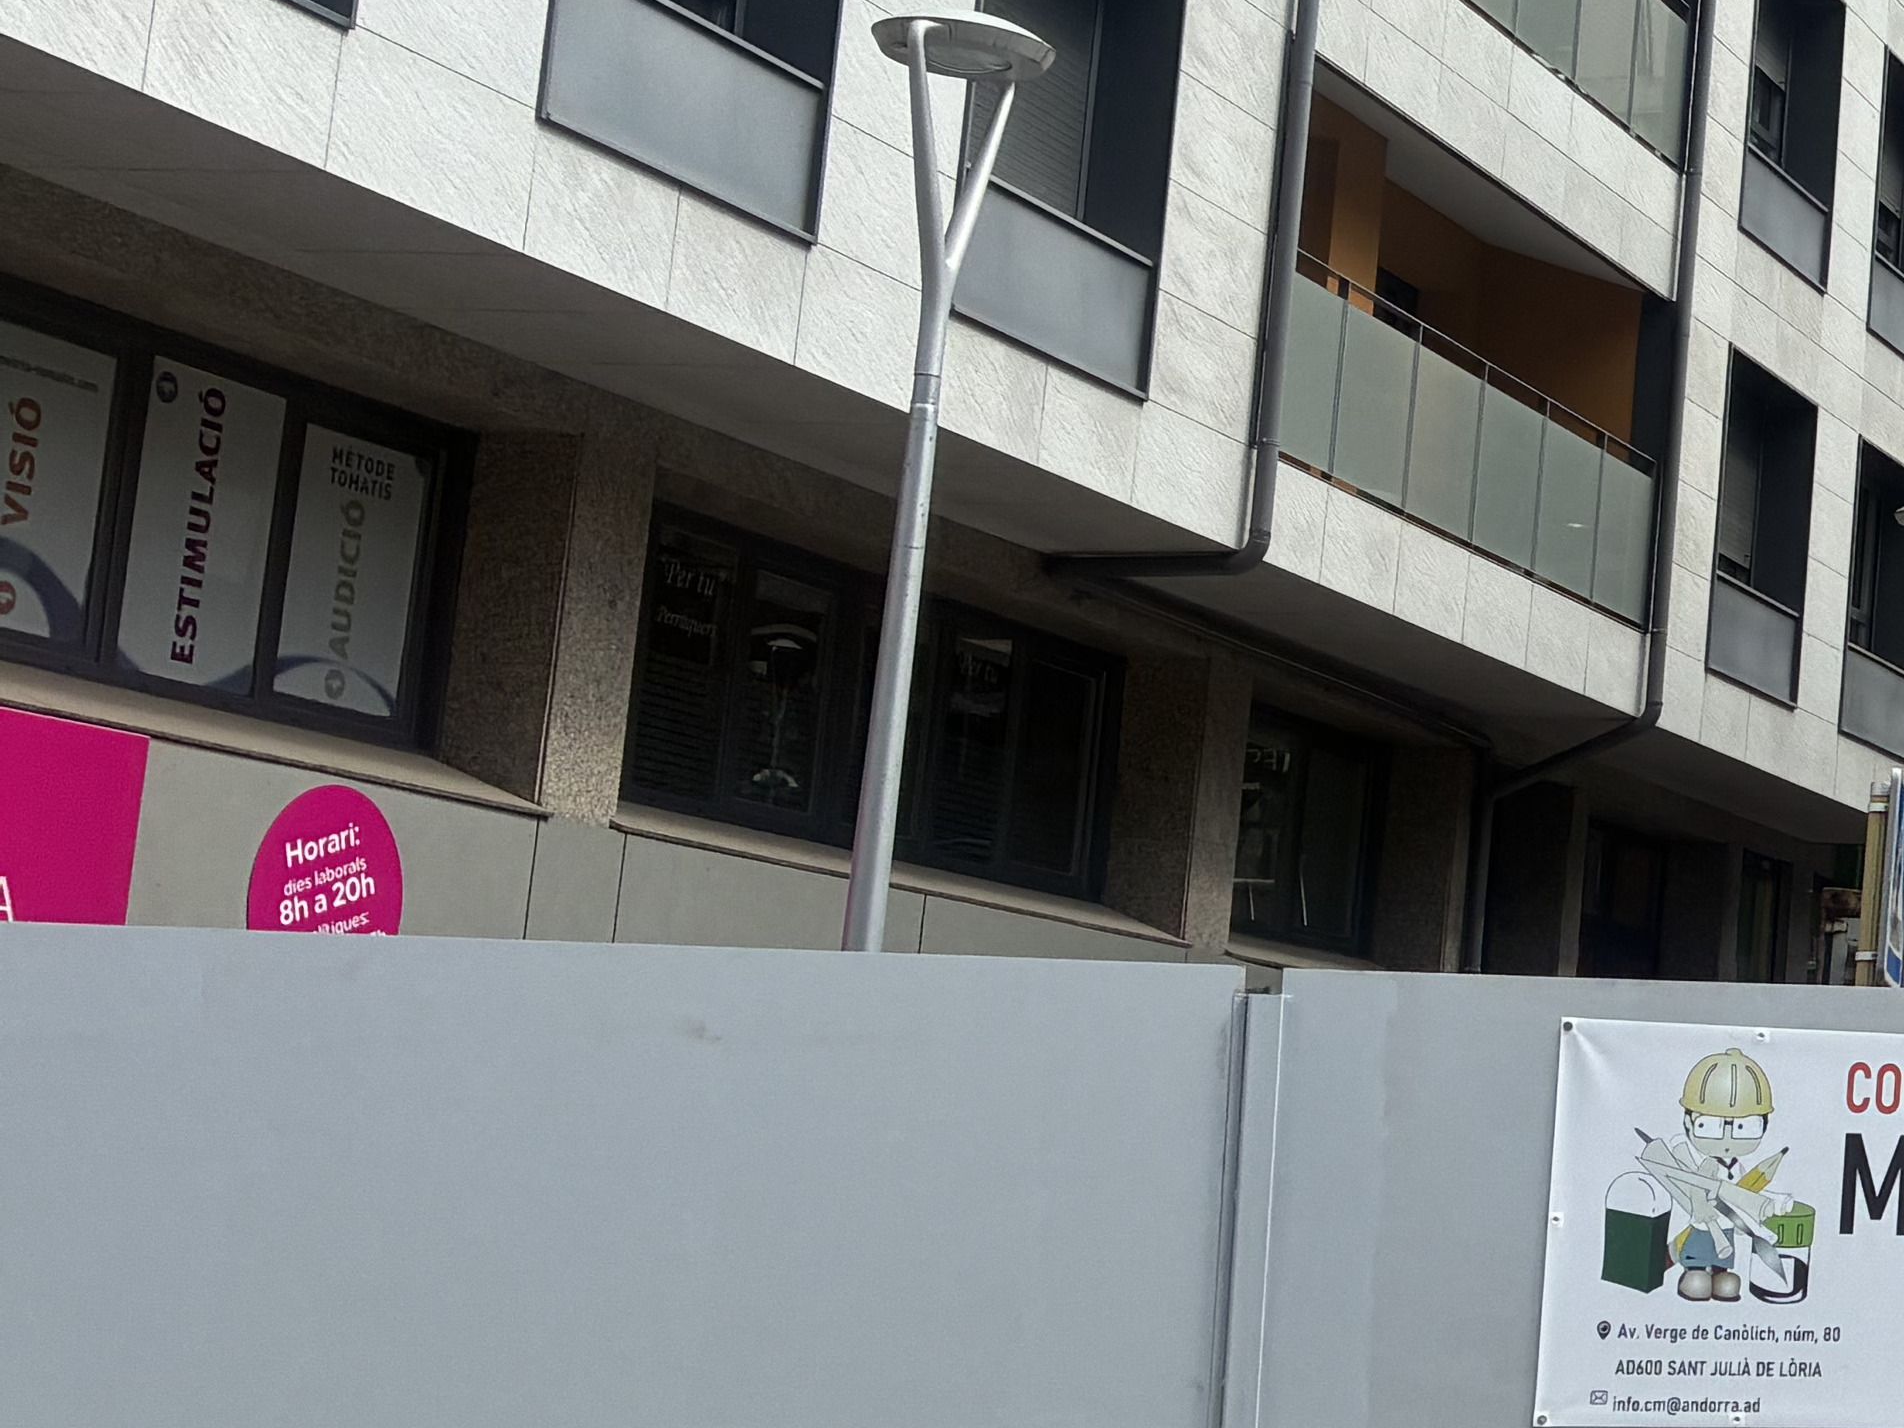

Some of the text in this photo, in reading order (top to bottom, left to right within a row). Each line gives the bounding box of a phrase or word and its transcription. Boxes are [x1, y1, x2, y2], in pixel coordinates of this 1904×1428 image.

[2, 397, 42, 525] VISIÓ
[330, 466, 393, 501] TOMATIS
[171, 387, 227, 665] ESTIMULACIÓ
[329, 498, 366, 661] AUDICIÓ
[285, 822, 360, 868] Horari:
[284, 857, 367, 896] dies laborals
[279, 896, 309, 926] 8h
[314, 893, 328, 913] a
[332, 873, 376, 908] 20h
[1617, 1323, 1841, 1344] Av. Verge de Canòlich, núm, 80
[1615, 1358, 1822, 1378] AD600 SANT JULIÀ DE LÒRIA
[1612, 1396, 1761, 1416] info.cm@andorra.ad
